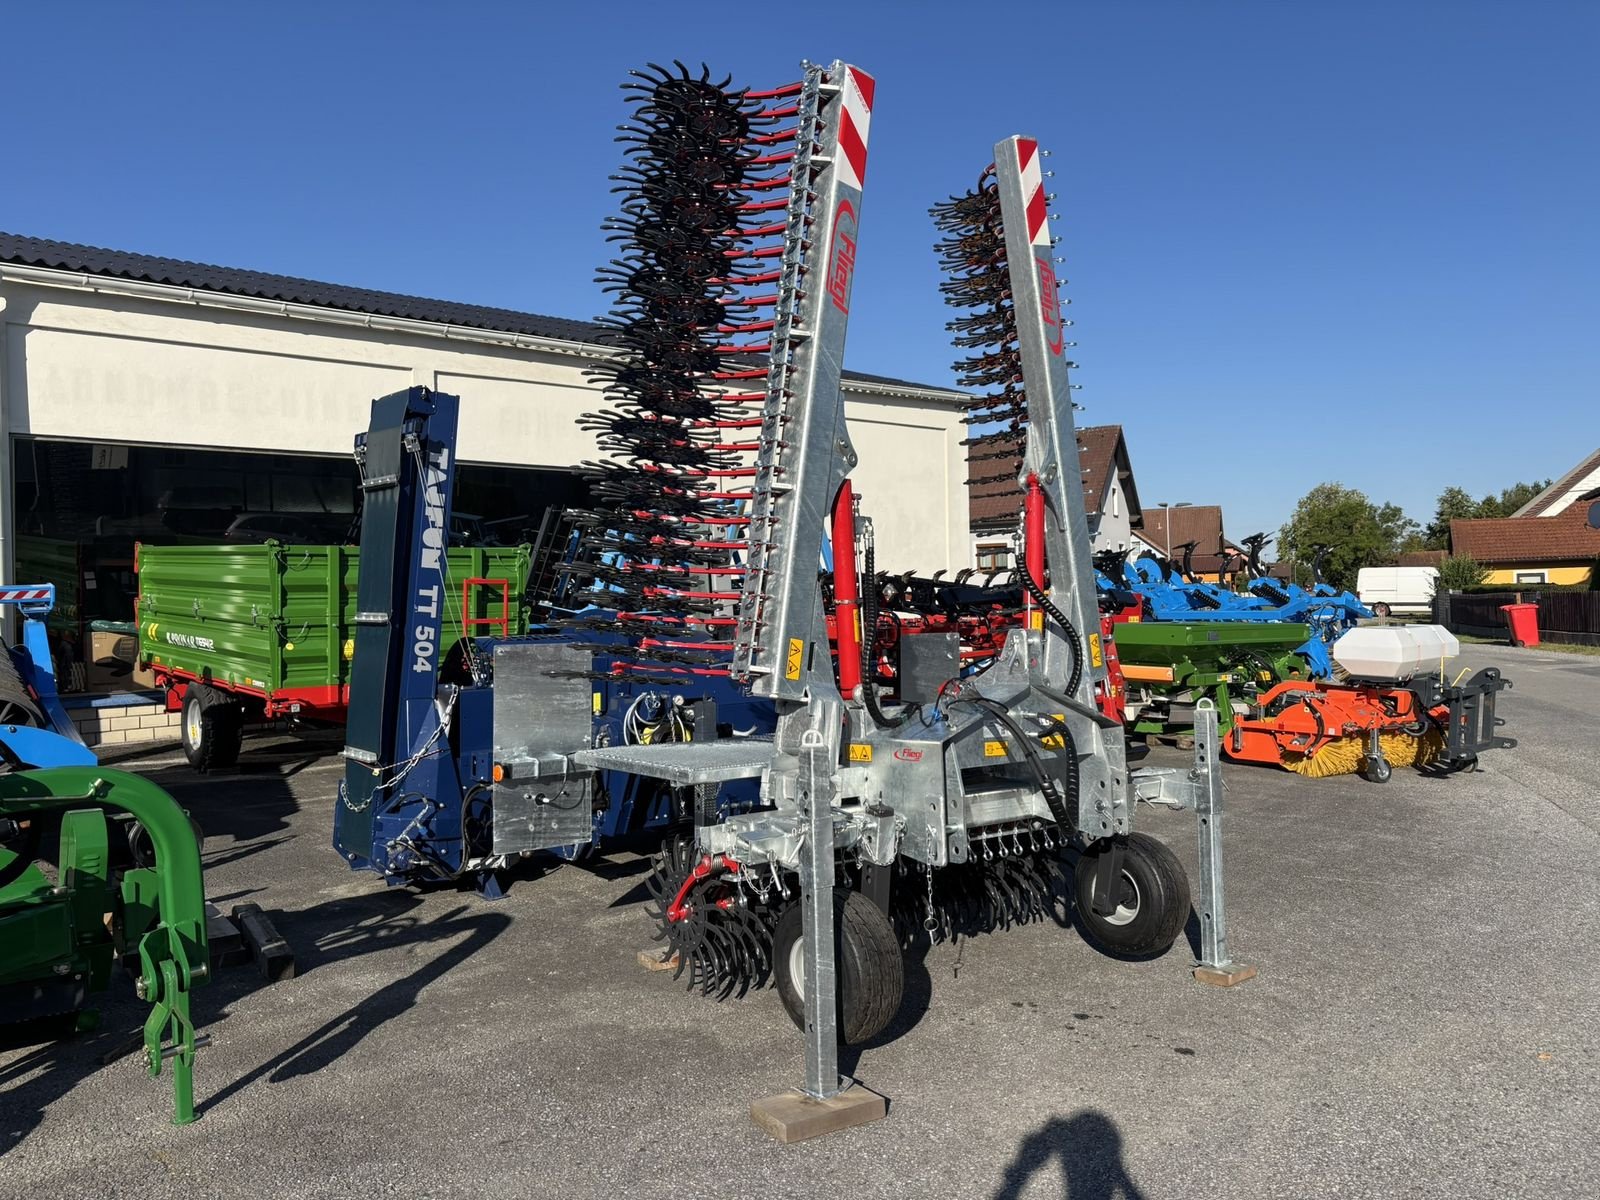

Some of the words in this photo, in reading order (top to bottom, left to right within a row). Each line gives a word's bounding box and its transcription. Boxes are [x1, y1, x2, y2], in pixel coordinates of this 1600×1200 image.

[829, 231, 857, 315] Fliegl
[1034, 256, 1058, 326] Fliegl
[418, 585, 438, 618] TT
[413, 625, 435, 673] 504
